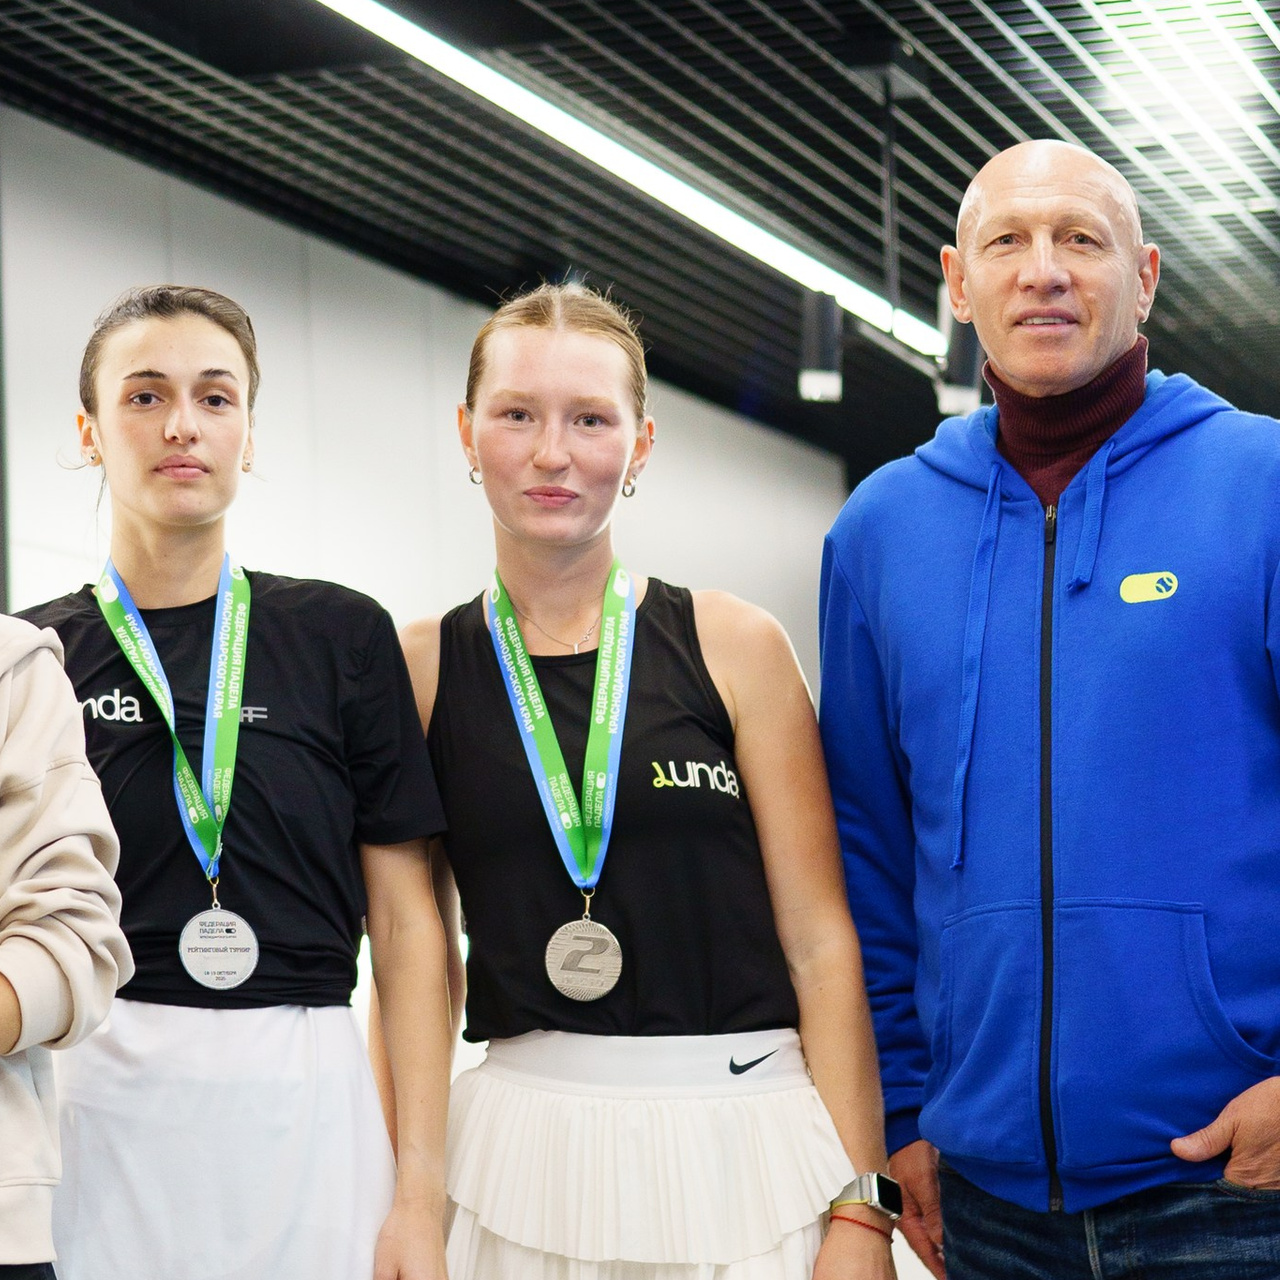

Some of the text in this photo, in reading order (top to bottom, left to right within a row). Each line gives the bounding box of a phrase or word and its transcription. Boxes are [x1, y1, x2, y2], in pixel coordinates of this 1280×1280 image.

[116, 625, 141, 664] ПАДЕЛА
[124, 613, 144, 639] КРАЯ
[212, 591, 234, 719] КРАСНОДАРСКОГО КРАЯ
[228, 602, 247, 710] ФЕДЕРАЦИЯ ПАДЕЛА
[493, 615, 536, 734] КРАСНОДАРСКОГО КРАЯ
[505, 616, 545, 720] ФЕДЕРАЦИЯ ПАДЕЛА
[595, 616, 616, 725] ФЕДЕРАЦИЯ ПАДЕЛА
[608, 610, 631, 734] КРАСНОДАРСКОГО КРАЯ
[80, 688, 144, 722] nda
[177, 771, 193, 807] ПАДЕЛА
[182, 766, 209, 820] ФЕДЕРАЦИЯ
[548, 776, 566, 812] ПАДЕЛА
[559, 772, 582, 828] ФЕДЕРАЦИЯ
[585, 770, 596, 827] ФЕДЕРАЦИЯ
[594, 790, 604, 828] ПАДЕЛА
[560, 934, 610, 974] 2
